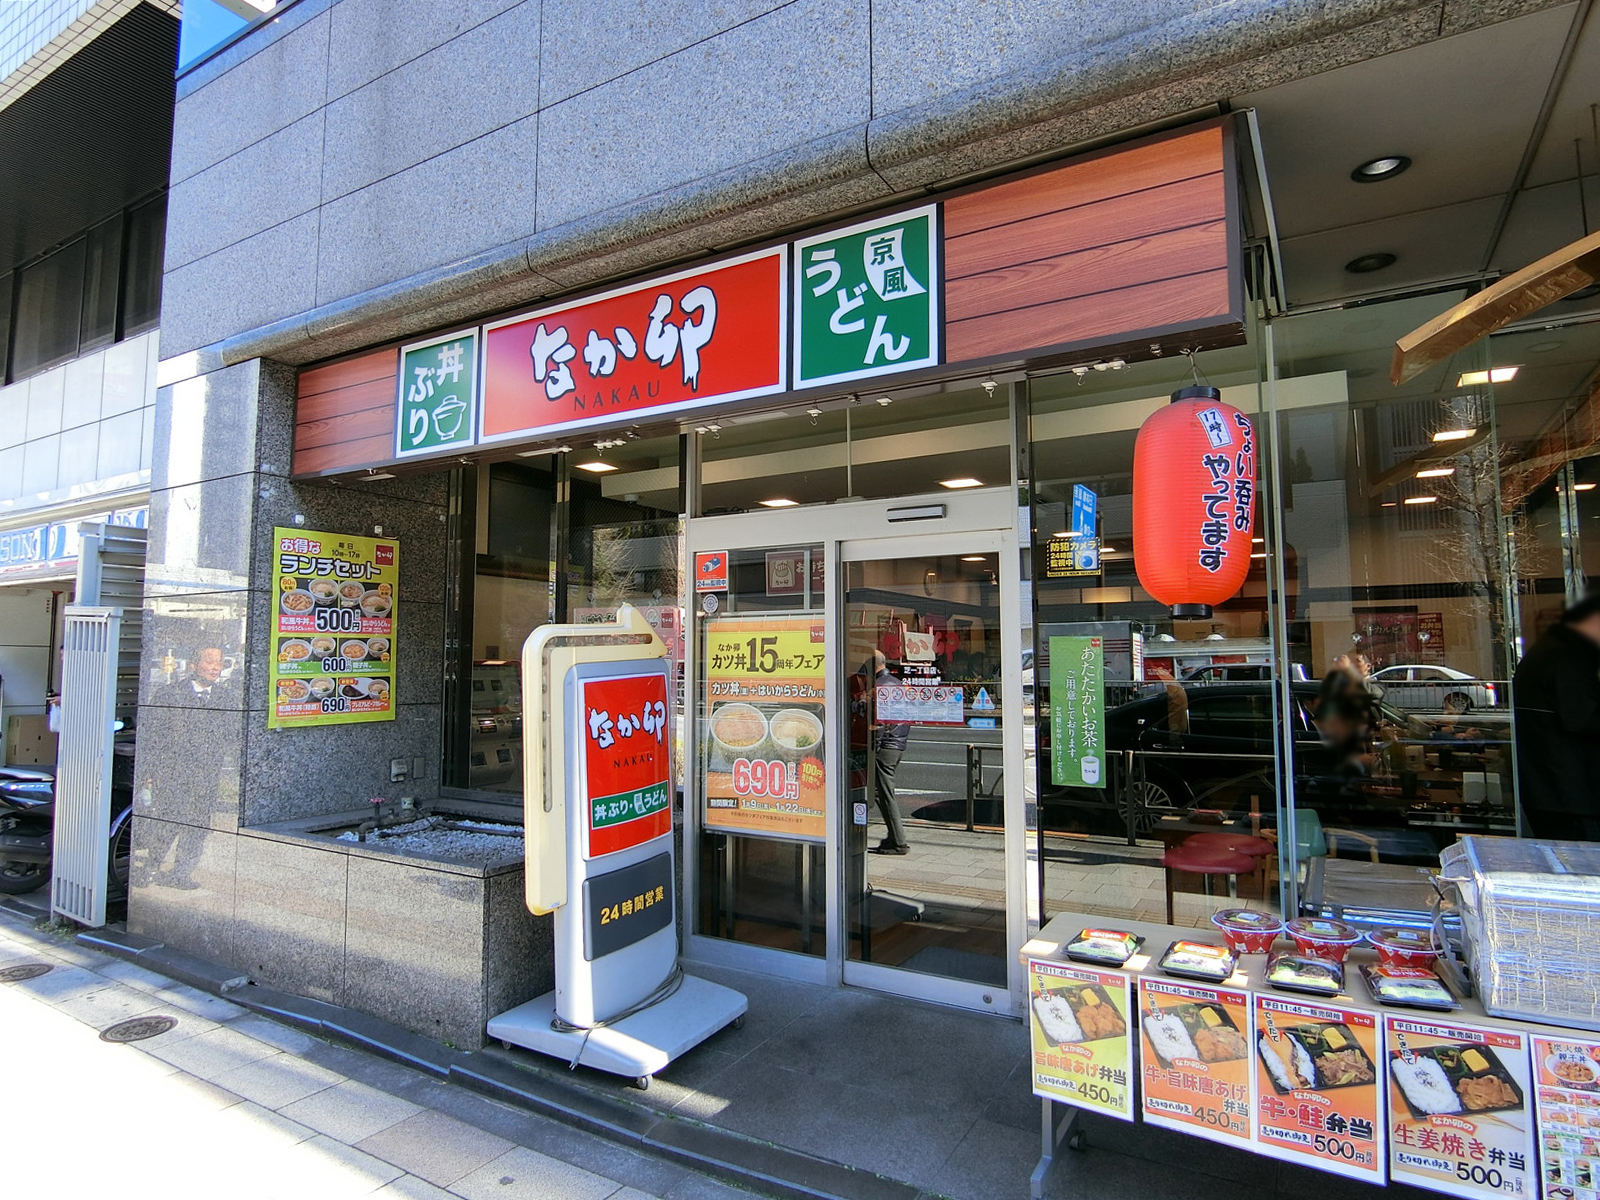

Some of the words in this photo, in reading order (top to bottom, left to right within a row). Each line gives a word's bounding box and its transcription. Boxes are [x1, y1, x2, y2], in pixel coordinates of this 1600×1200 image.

[870, 237, 908, 297] 京風
[805, 249, 911, 365] うどん
[530, 285, 718, 401] なか卯
[407, 342, 464, 446] 丼ぶり
[573, 380, 661, 412] NAKAU
[1199, 453, 1231, 573] やってます
[280, 537, 322, 555] お得な
[1050, 541, 1097, 552] 防犯カメラ
[280, 554, 381, 580] ランチセット
[717, 643, 741, 652] なか卯
[1080, 646, 1098, 748] あたたかいお茶
[588, 700, 667, 749] なか卯
[1065, 669, 1078, 763] ご用意しております。
[733, 757, 799, 800] 690円
[600, 885, 664, 925] 24時間営業
[1263, 1011, 1280, 1042] できたて
[1395, 1033, 1414, 1065] できたて
[1078, 1081, 1118, 1107] 450円
[1223, 1099, 1249, 1118] 弁当
[1194, 1106, 1240, 1132] 450円
[1313, 1134, 1365, 1164] 500円
[1456, 1162, 1514, 1192] 500円
